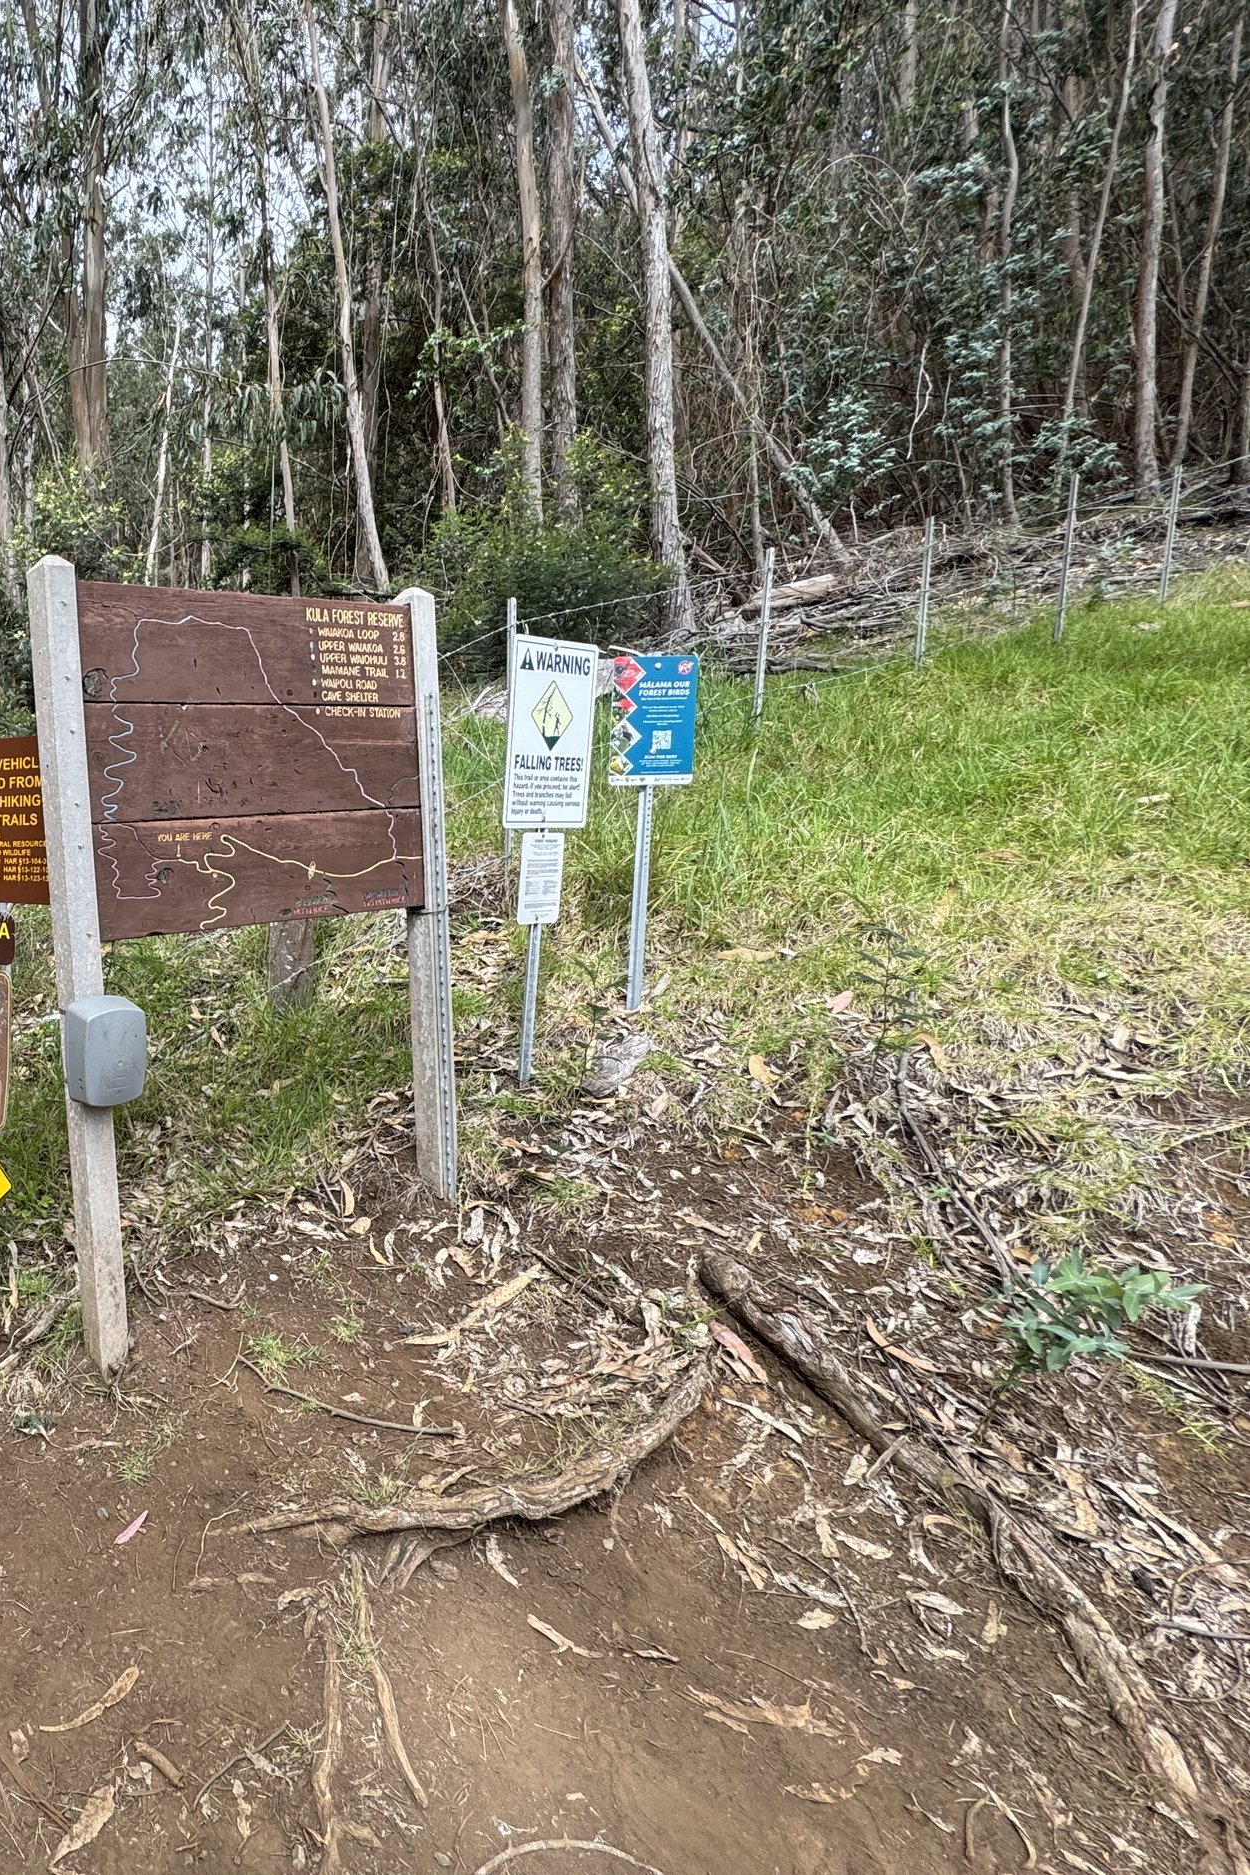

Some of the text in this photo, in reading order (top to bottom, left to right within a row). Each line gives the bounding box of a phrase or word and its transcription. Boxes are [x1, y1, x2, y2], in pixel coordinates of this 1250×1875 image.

[306, 607, 404, 628] KULA FOREST RESERVE
[318, 627, 405, 642] WAIAKOA LOOP 2.8
[318, 641, 405, 655] UPPER WAIAKOA 2.6
[320, 653, 406, 667] UPPER WAIOHULI 3.8
[536, 650, 590, 676] WARNING
[322, 665, 360, 676] MAMANE
[364, 666, 389, 678] TRAIL
[321, 678, 377, 689] WAIPOLI ROAD
[322, 691, 378, 702] CAVE SHELTER
[324, 706, 401, 718] CHECK-IN STATION
[514, 754, 584, 772] FALLING TREES!
[9, 775, 42, 789] FROM
[0, 794, 41, 808] HIKING
[158, 832, 212, 842] YOU ARE HERE
